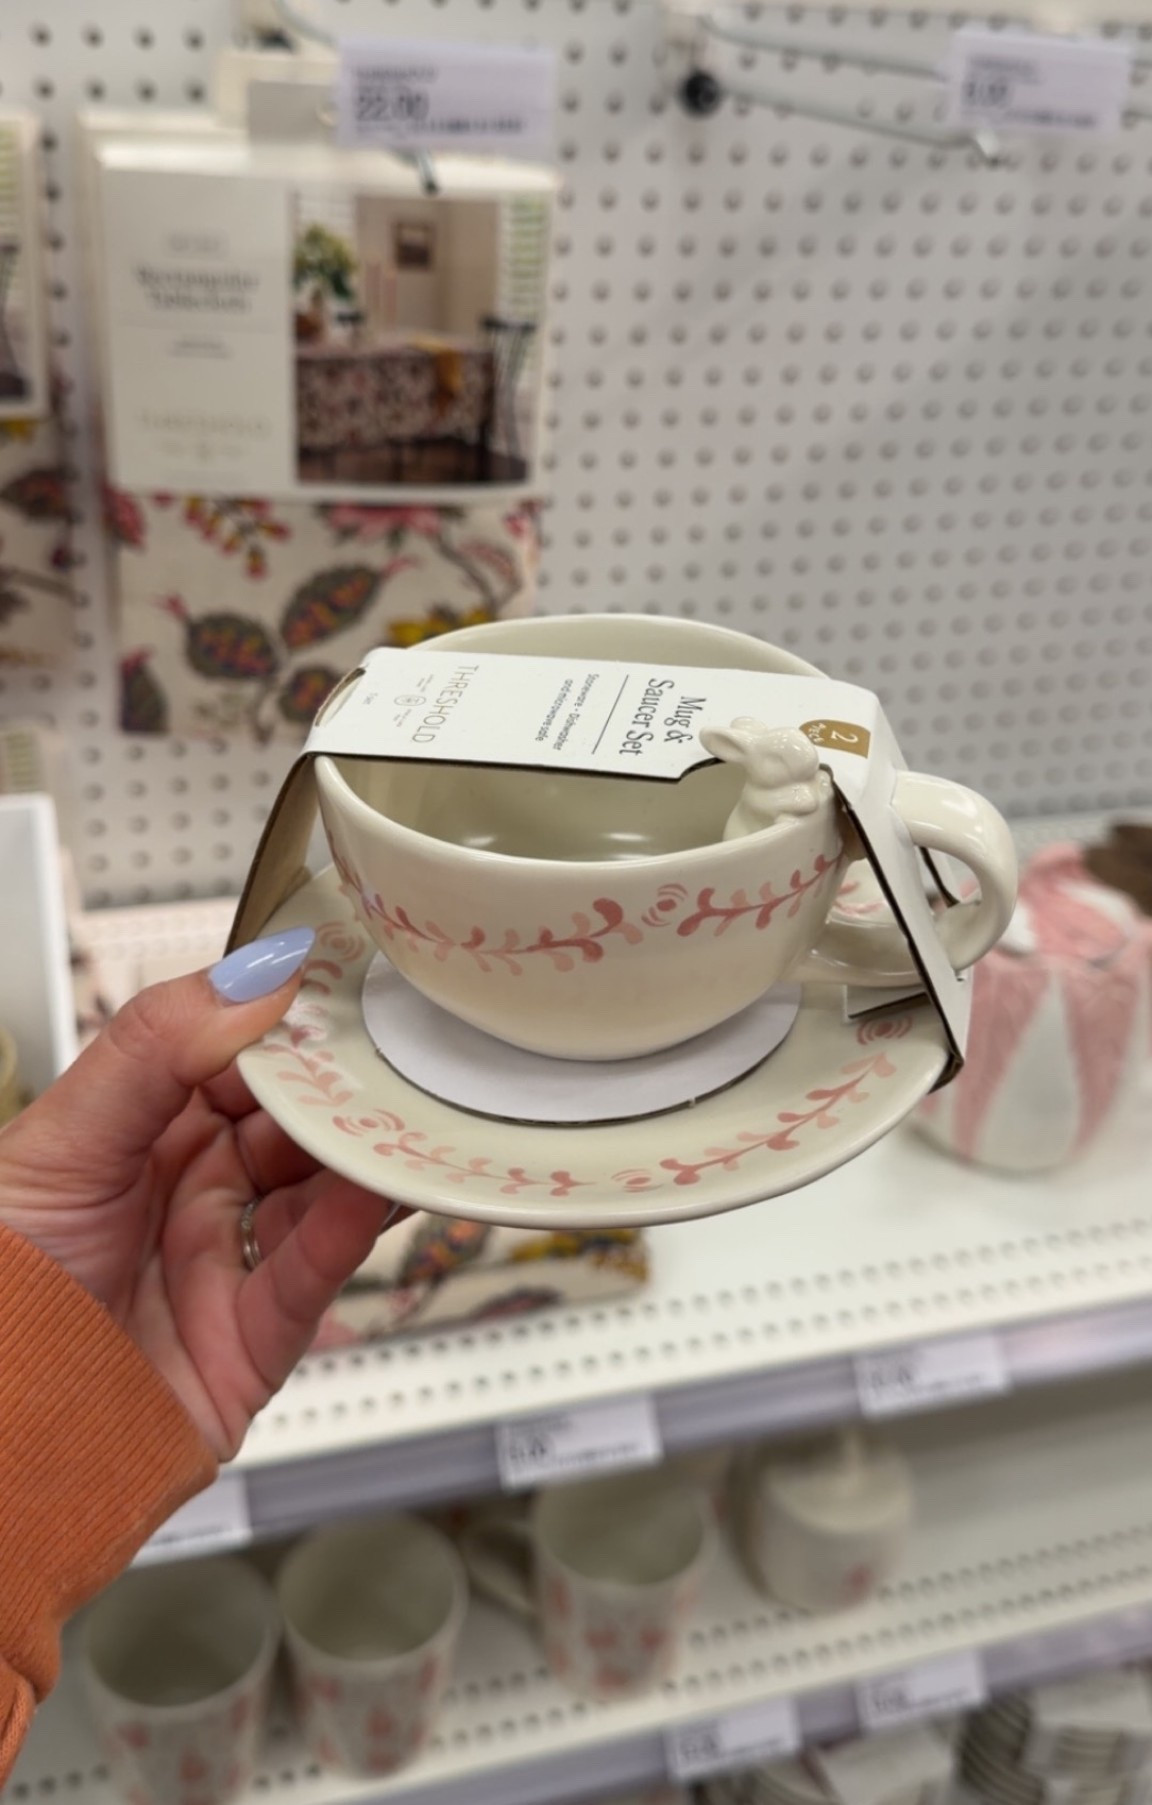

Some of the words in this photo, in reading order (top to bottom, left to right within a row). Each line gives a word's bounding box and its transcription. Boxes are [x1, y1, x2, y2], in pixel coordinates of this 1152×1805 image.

[412, 665, 479, 743] THRESHOLD
[574, 673, 600, 707] Stoneware
[632, 678, 675, 728] Saucer
[663, 696, 707, 728] Mug
[553, 713, 580, 751] Dishwasher
[619, 730, 654, 756] Set
[663, 730, 693, 744] &
[830, 730, 859, 743] 2
